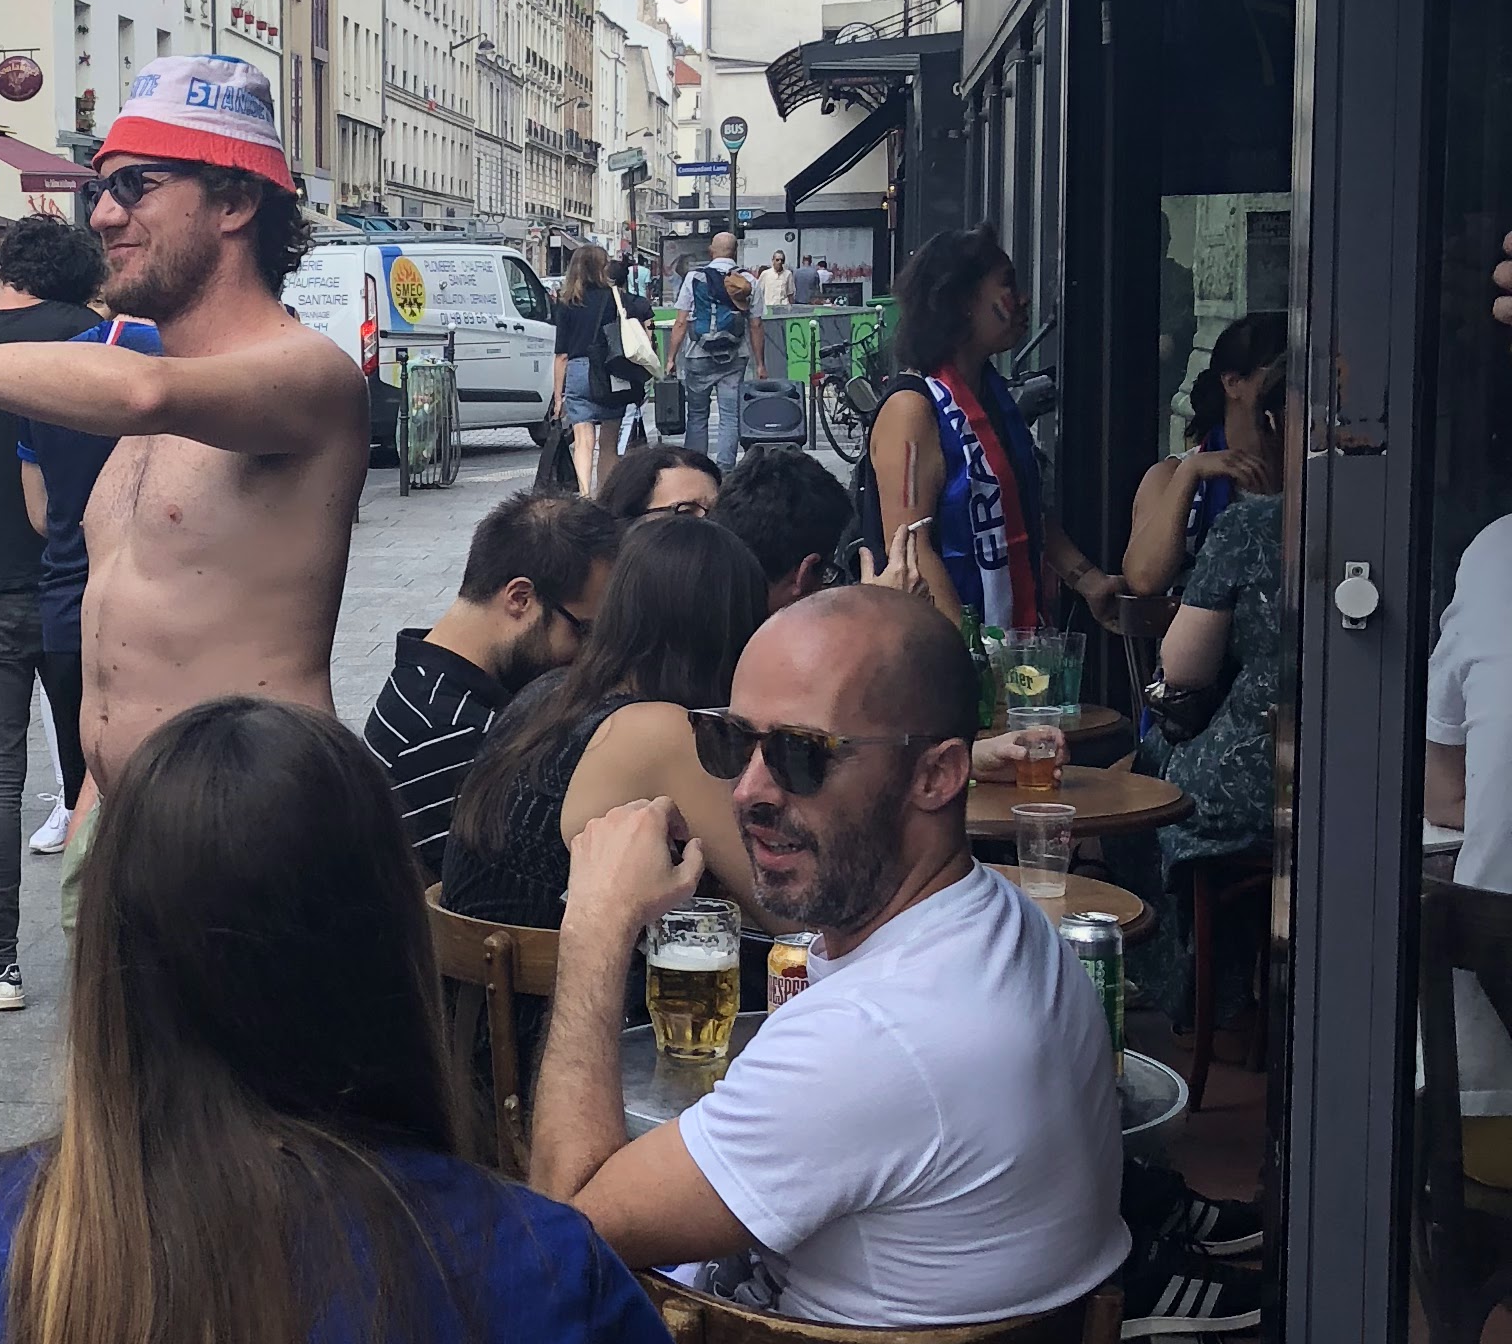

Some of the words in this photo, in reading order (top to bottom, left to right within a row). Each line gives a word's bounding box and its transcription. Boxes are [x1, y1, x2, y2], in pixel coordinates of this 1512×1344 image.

[189, 79, 219, 106] 51
[724, 123, 744, 135] BUS
[395, 284, 423, 296] SMEC
[298, 294, 348, 305] SANITAIRE
